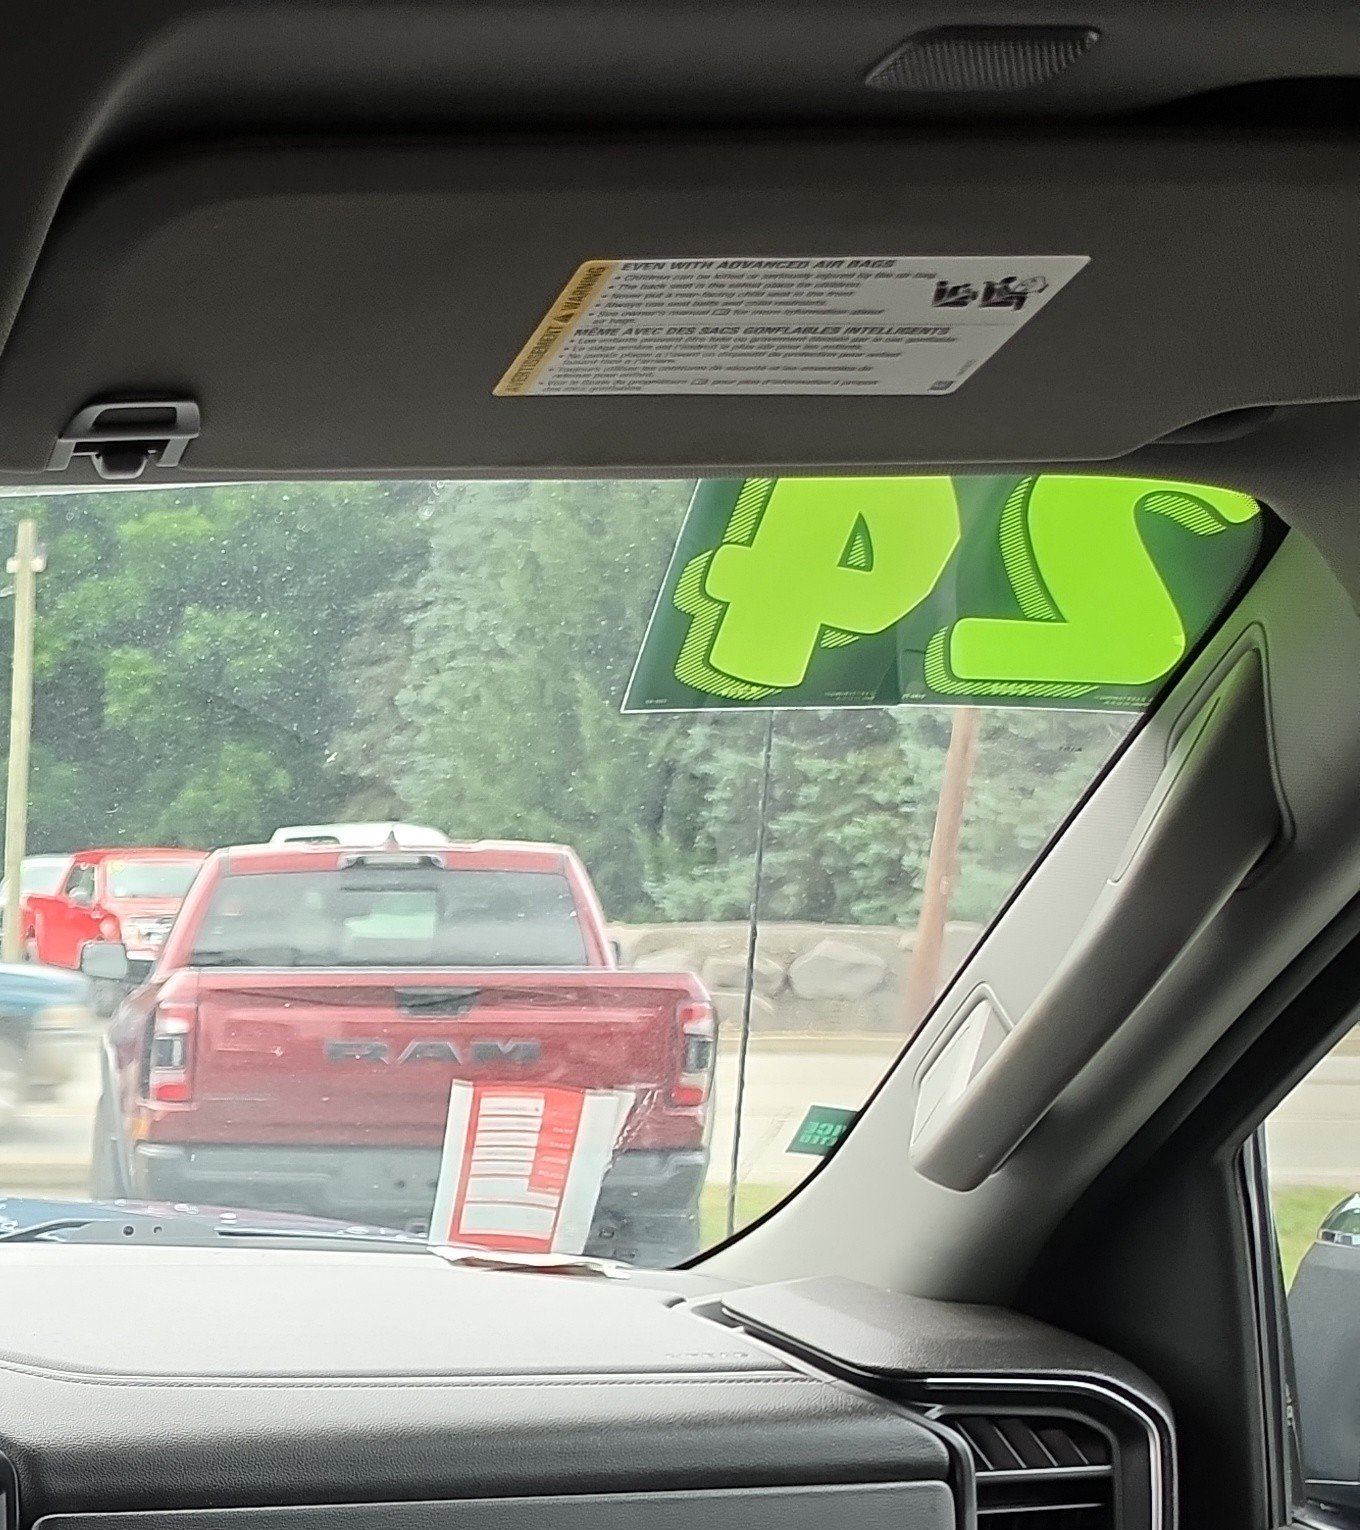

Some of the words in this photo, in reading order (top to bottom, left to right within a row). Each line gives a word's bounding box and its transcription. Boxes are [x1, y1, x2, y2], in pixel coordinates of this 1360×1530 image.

[622, 262, 666, 271] EVEN
[670, 262, 713, 270] WITH
[717, 260, 810, 270] ADVANCED
[813, 260, 844, 268] AIR
[847, 260, 897, 268] BAGS
[562, 267, 606, 311] WARNING
[622, 326, 664, 336] AVEC
[666, 326, 696, 336] DES
[698, 326, 740, 336] SACS
[743, 326, 842, 336] GONFLABLES
[844, 326, 951, 336] INTELLIGENTS
[325, 1038, 541, 1064] RAM
